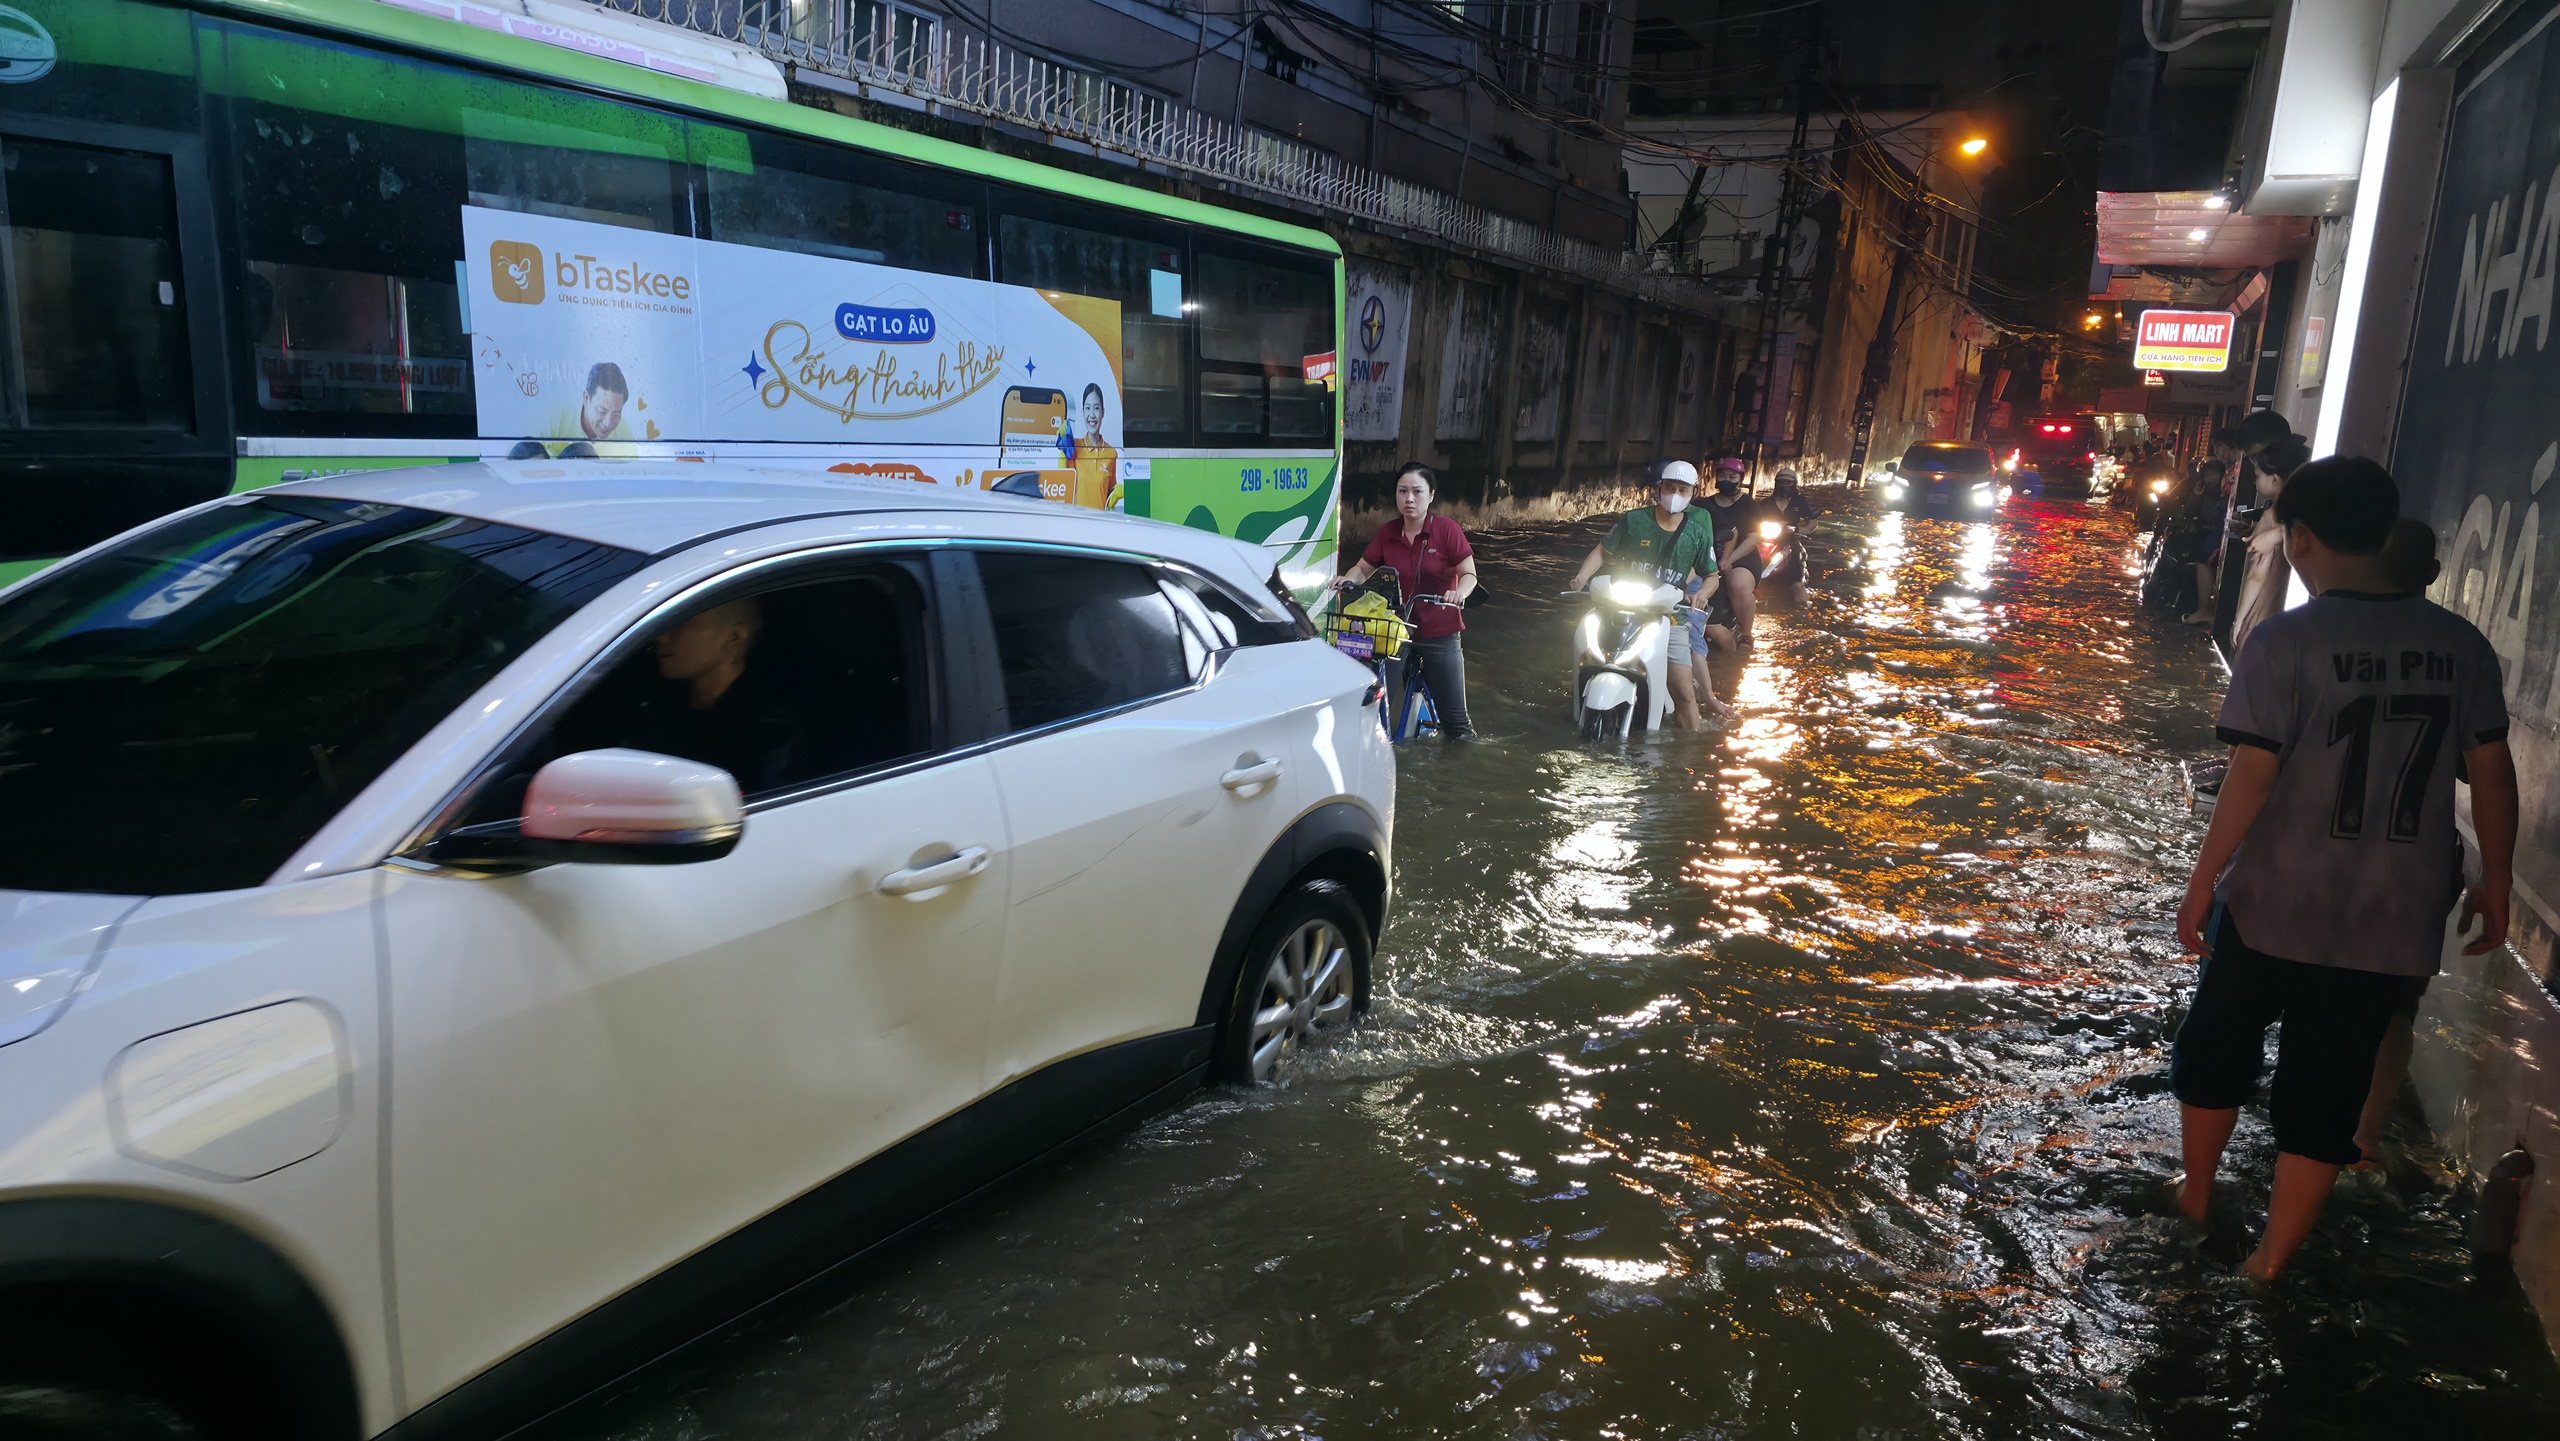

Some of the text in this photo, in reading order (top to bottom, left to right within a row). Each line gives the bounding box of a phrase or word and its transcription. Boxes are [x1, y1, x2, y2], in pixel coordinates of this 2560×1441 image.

[555, 252, 690, 300] bTaskee
[558, 292, 692, 315] ỨNG DỤNG TIỆN ÍCH GIA ĐÌNH
[843, 312, 929, 336] GẠT LO ÂU
[2145, 322, 2225, 343] LINH MART
[2141, 352, 2222, 365] CỬA HÀNG TIỆN ÍCH
[762, 319, 868, 424] Sống
[867, 349, 955, 405] thảnh
[1241, 468, 1262, 491] 29B
[1273, 467, 1308, 490] 196.33
[2333, 650, 2387, 682] Văn
[2326, 693, 2451, 844] 17
